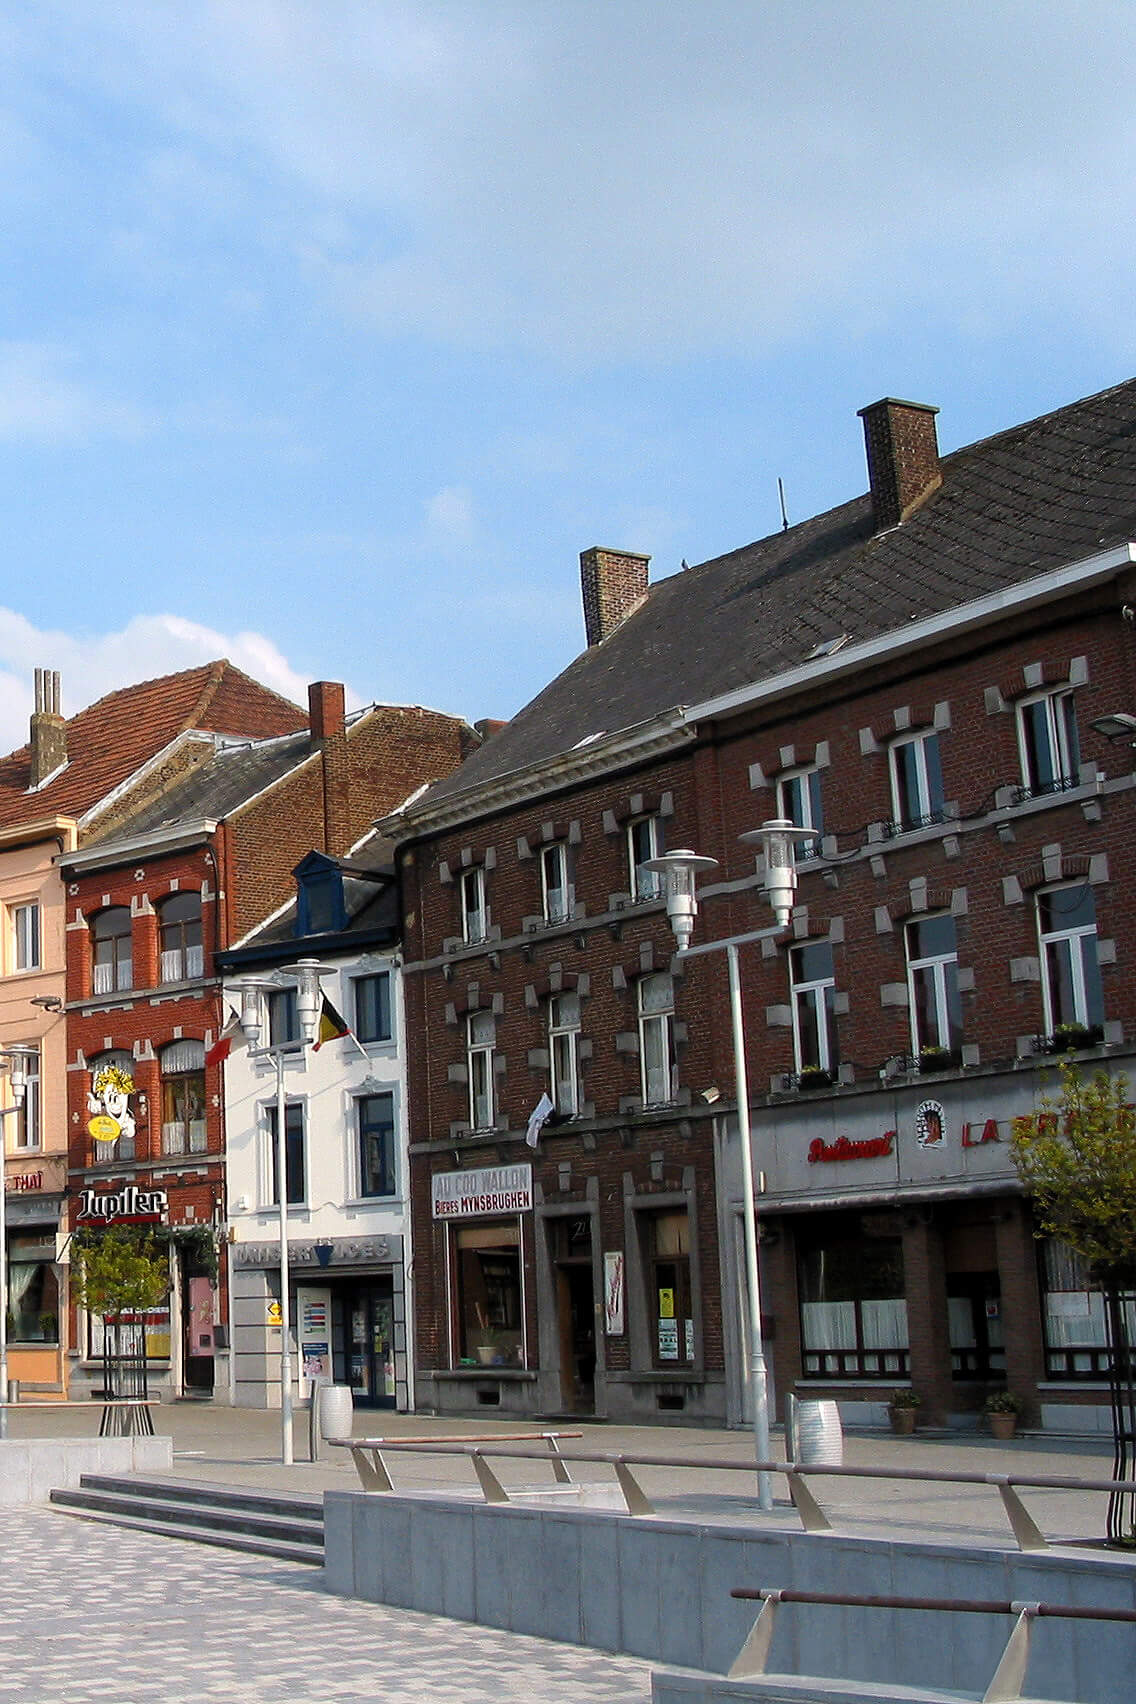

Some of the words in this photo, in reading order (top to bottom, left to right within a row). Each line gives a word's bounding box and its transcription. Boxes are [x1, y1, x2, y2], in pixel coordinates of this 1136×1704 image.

[962, 1119, 1000, 1147] LA
[76, 1186, 168, 1223] Jupiler
[460, 1191, 530, 1213] MYNSBRUGHEN
